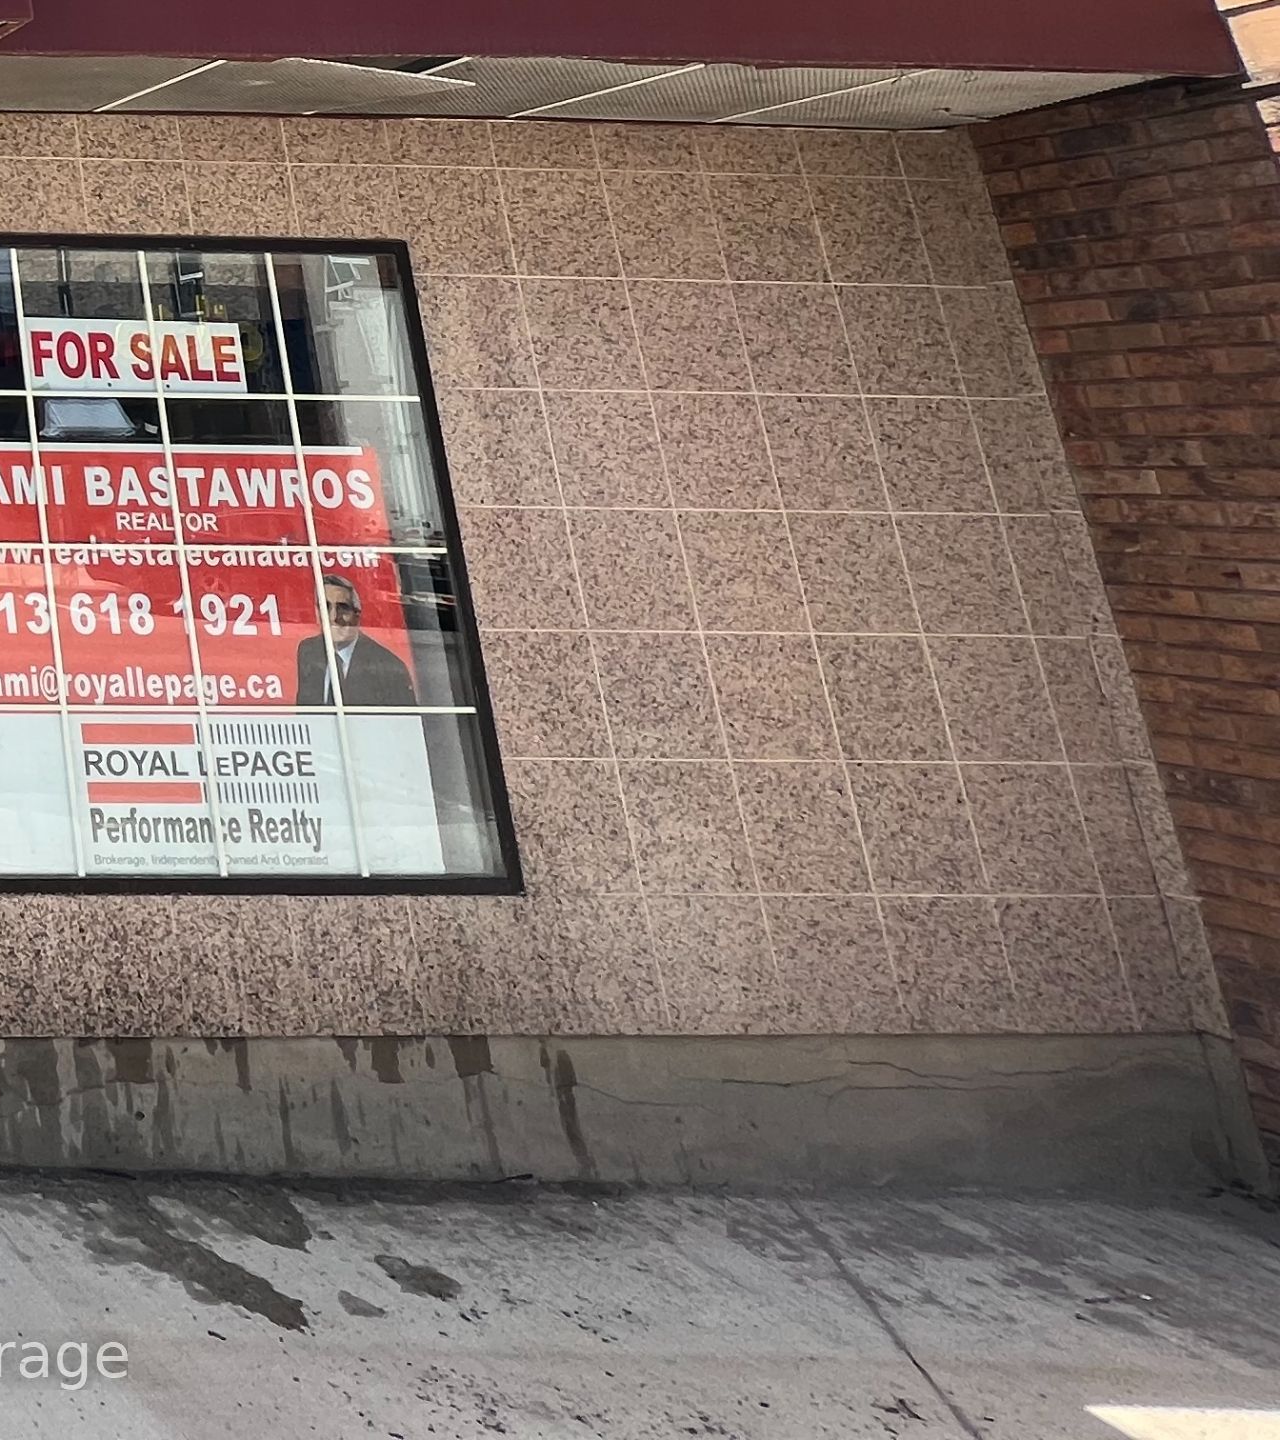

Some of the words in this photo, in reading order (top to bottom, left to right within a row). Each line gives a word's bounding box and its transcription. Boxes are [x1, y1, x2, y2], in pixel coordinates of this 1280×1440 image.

[30, 331, 120, 379] FOR
[129, 333, 242, 383] SALE
[84, 465, 376, 510] BASTAWROS
[115, 511, 220, 532] REALOR
[69, 592, 155, 636] 618
[172, 592, 283, 636] 1921
[83, 750, 190, 777] ROYAL
[247, 808, 323, 853] Realty
[260, 853, 281, 865] And
